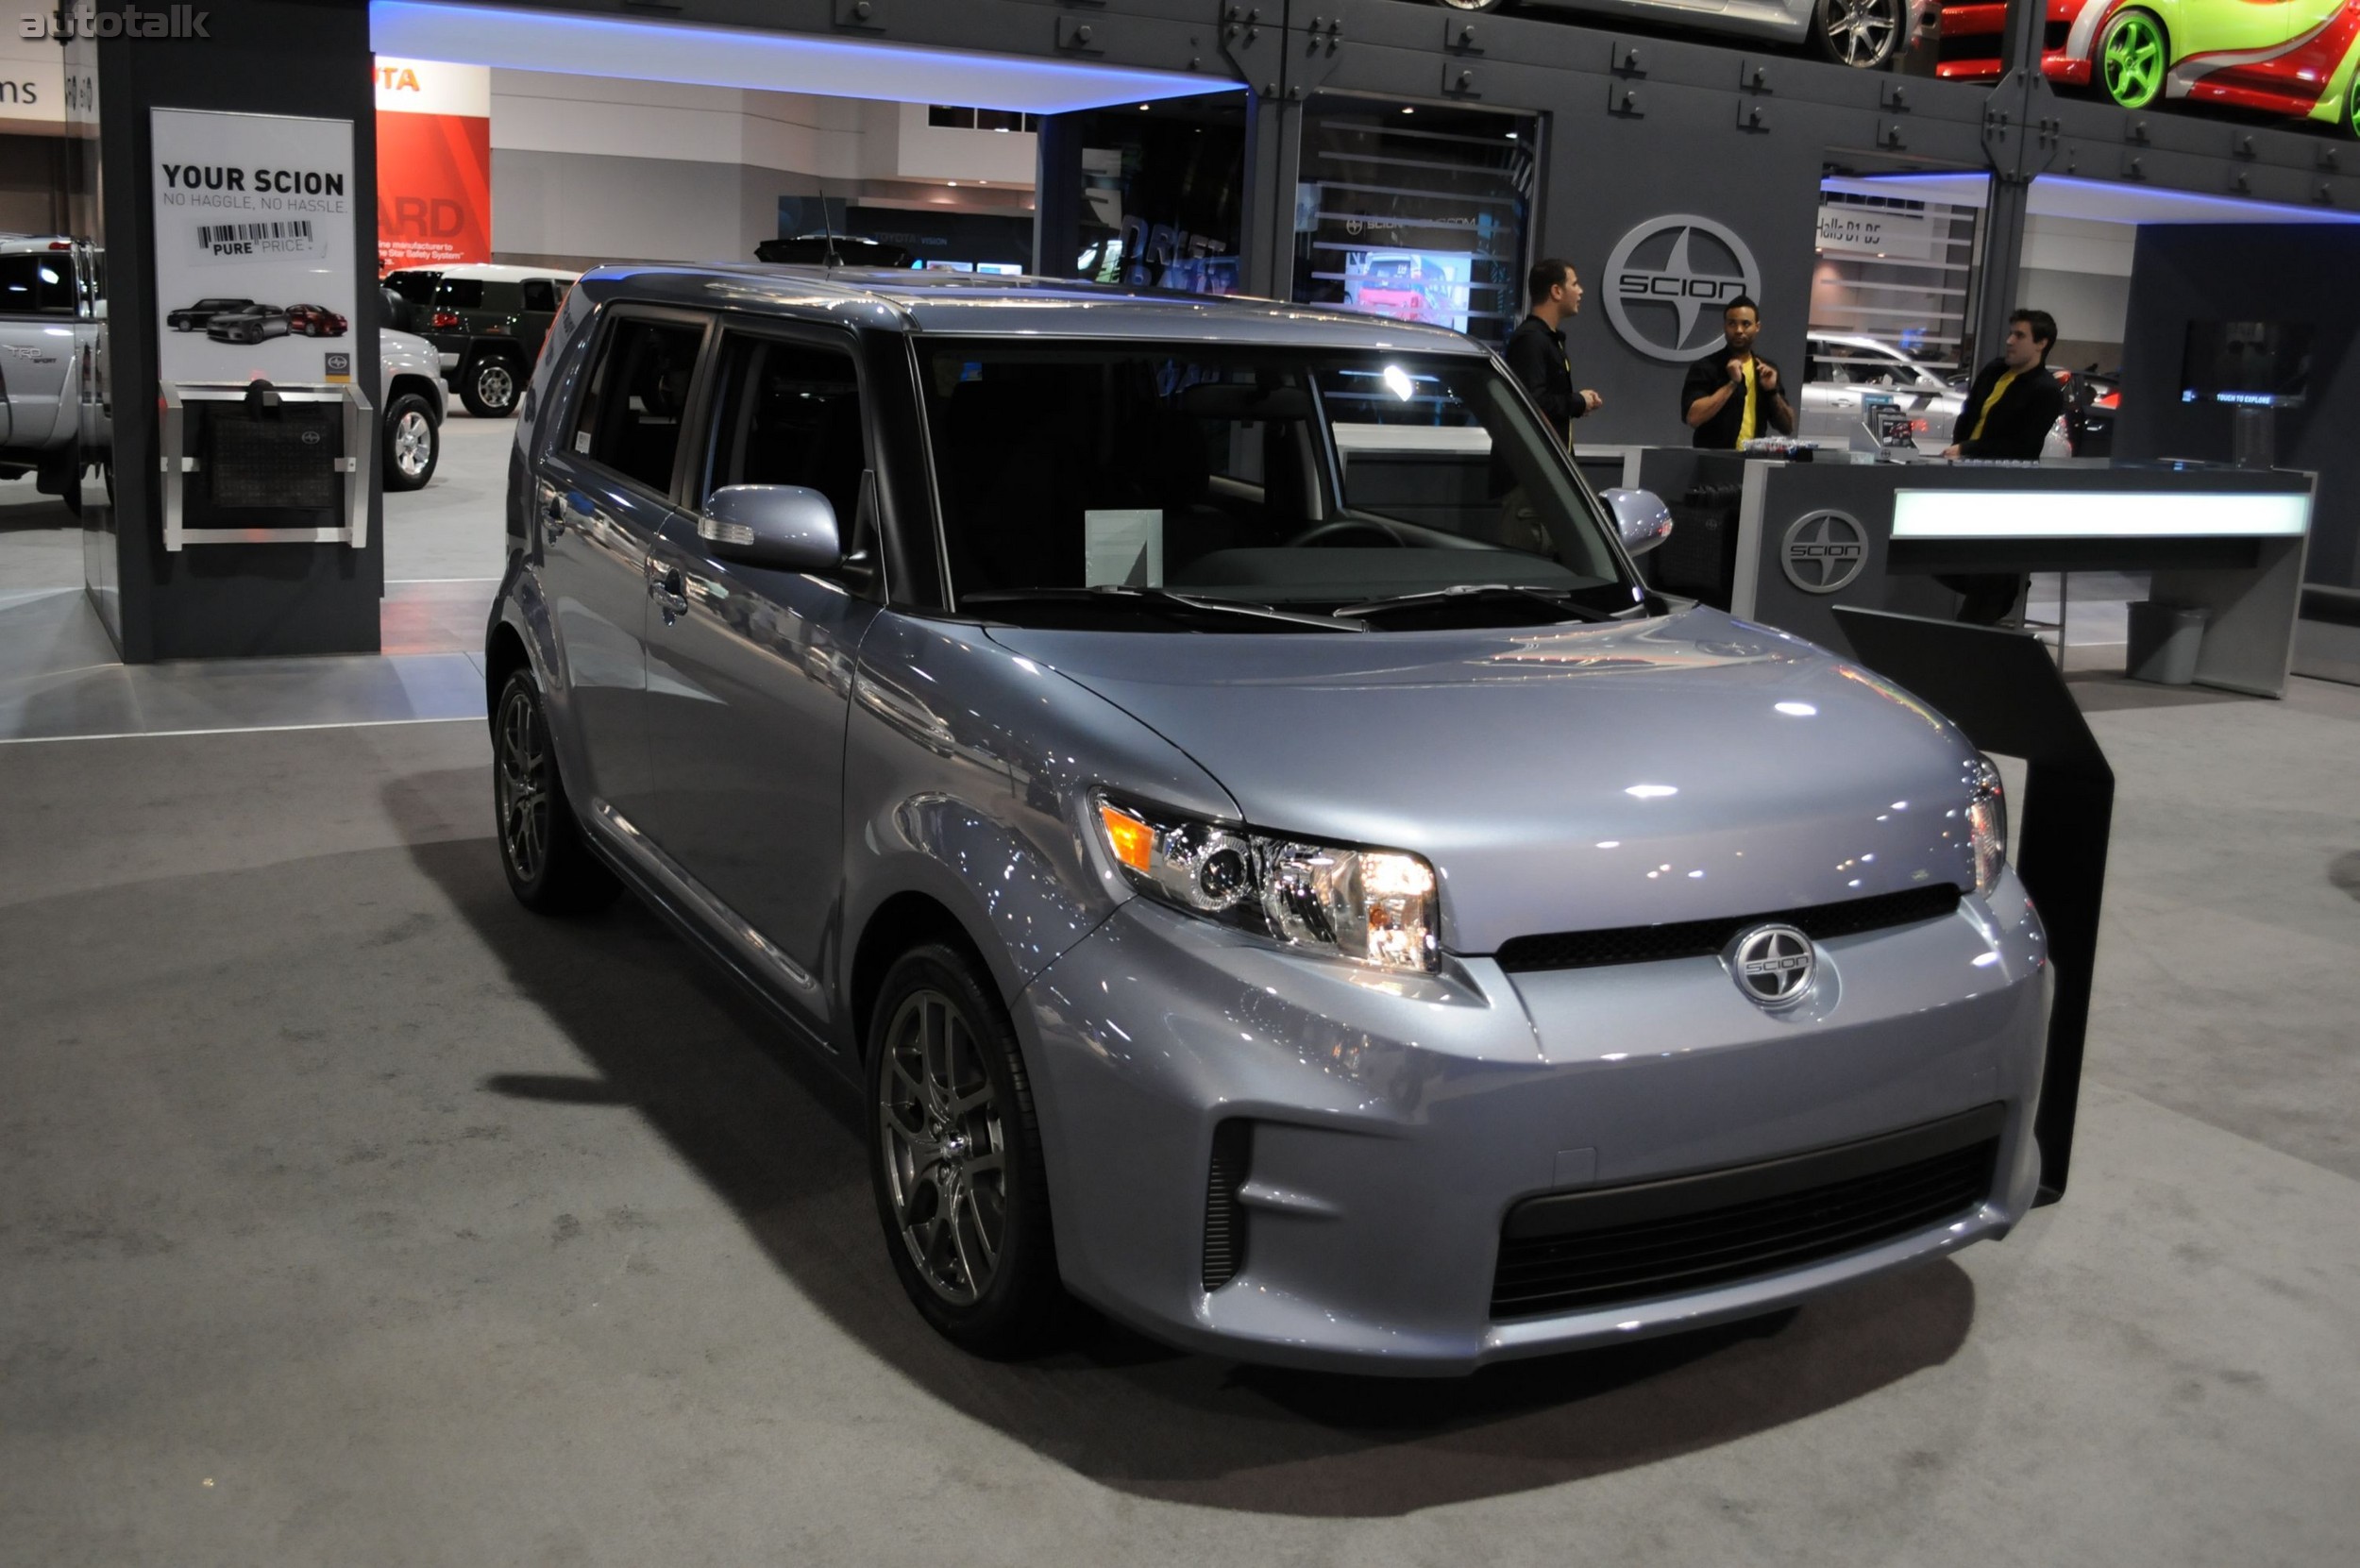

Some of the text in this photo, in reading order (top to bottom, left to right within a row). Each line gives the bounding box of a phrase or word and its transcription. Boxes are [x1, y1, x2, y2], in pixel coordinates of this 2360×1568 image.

[373, 67, 420, 92] TA
[161, 163, 345, 196] YOUR SCION
[163, 193, 348, 214] NO HAGGLE, NO HASSLE.
[213, 242, 253, 256] PURE
[1619, 274, 1746, 299] SCION
[2217, 394, 2236, 402] TOUCH
[1790, 545, 1861, 557] SCION
[1745, 955, 1810, 975] SCION
